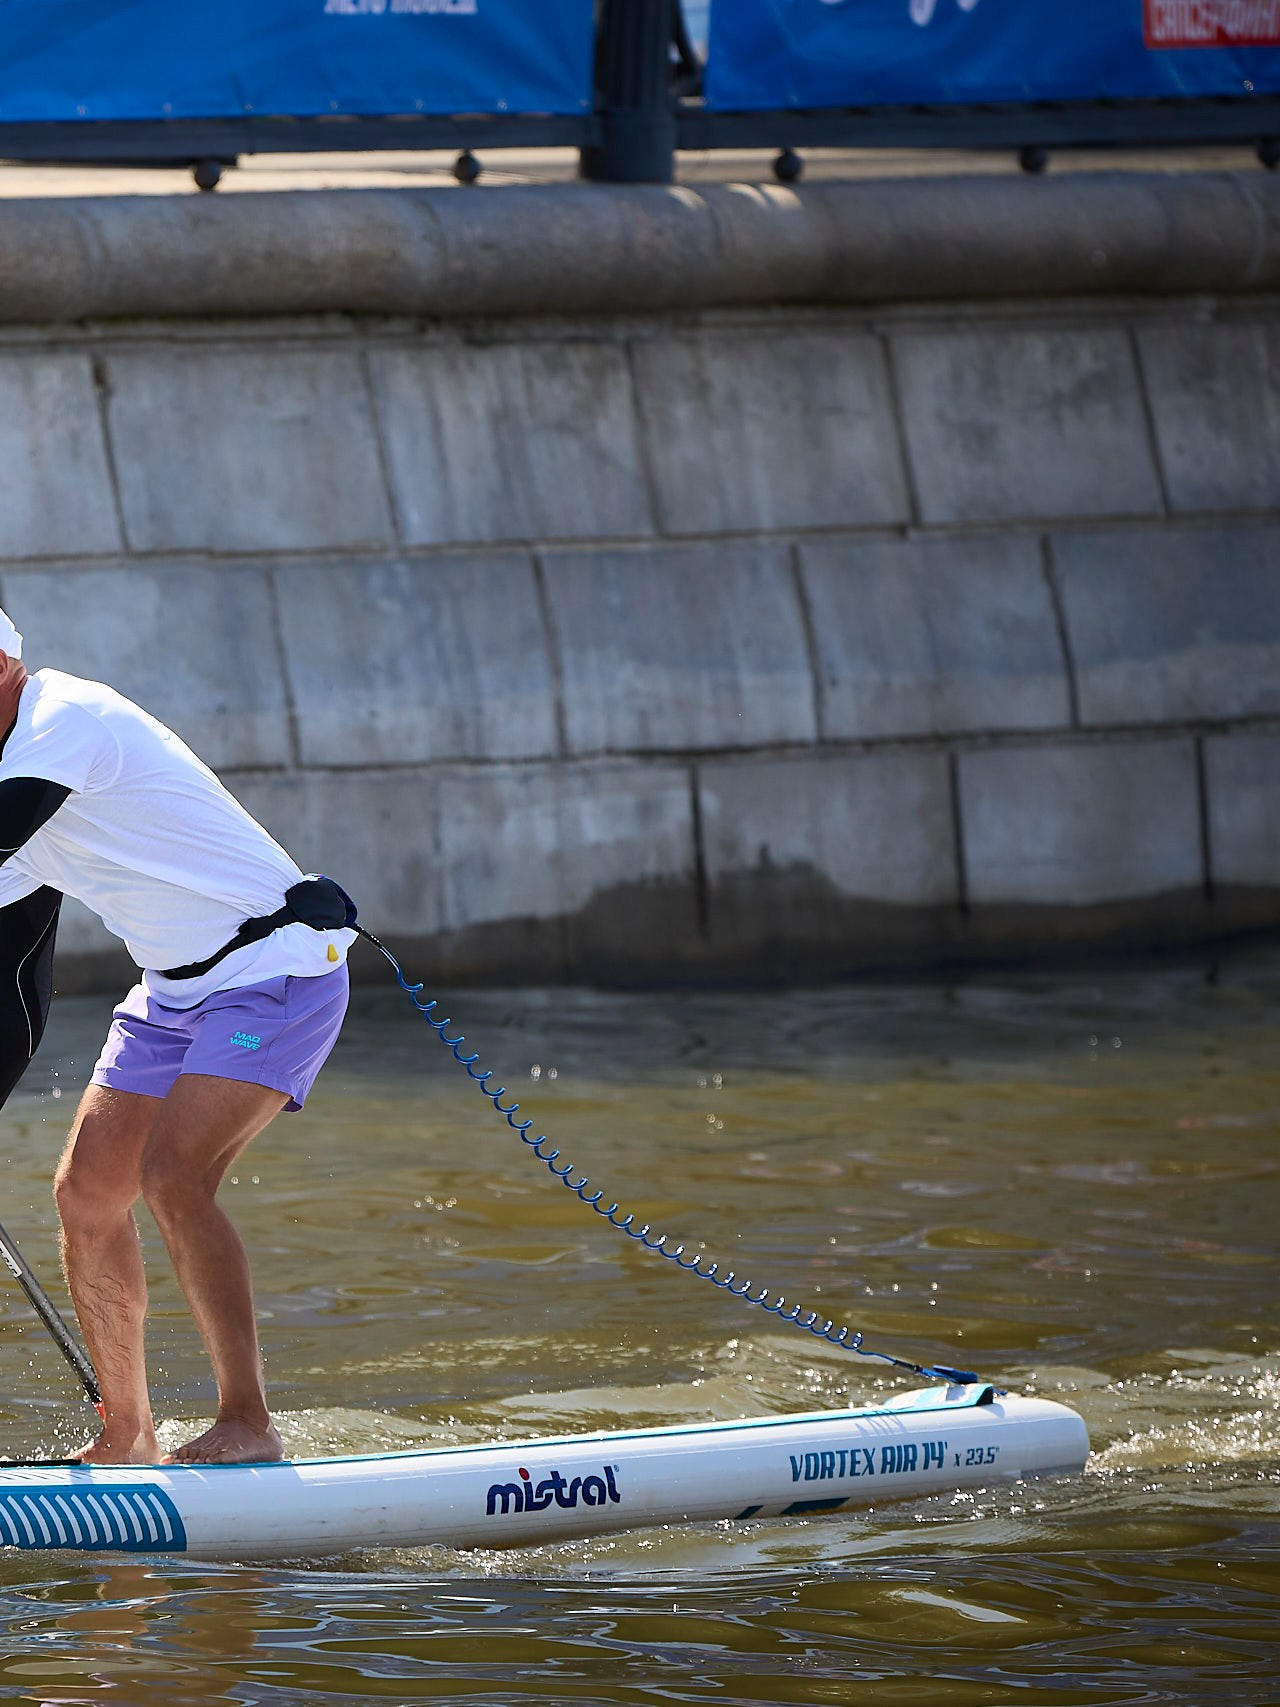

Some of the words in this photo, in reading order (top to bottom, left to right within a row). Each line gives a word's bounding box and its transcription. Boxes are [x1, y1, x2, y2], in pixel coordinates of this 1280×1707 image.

[230, 1037, 261, 1050] WAVE
[235, 1031, 261, 1043] MAD
[789, 1447, 876, 1482] VORTEX
[881, 1443, 918, 1474] AIR
[485, 1466, 622, 1516] mistral
